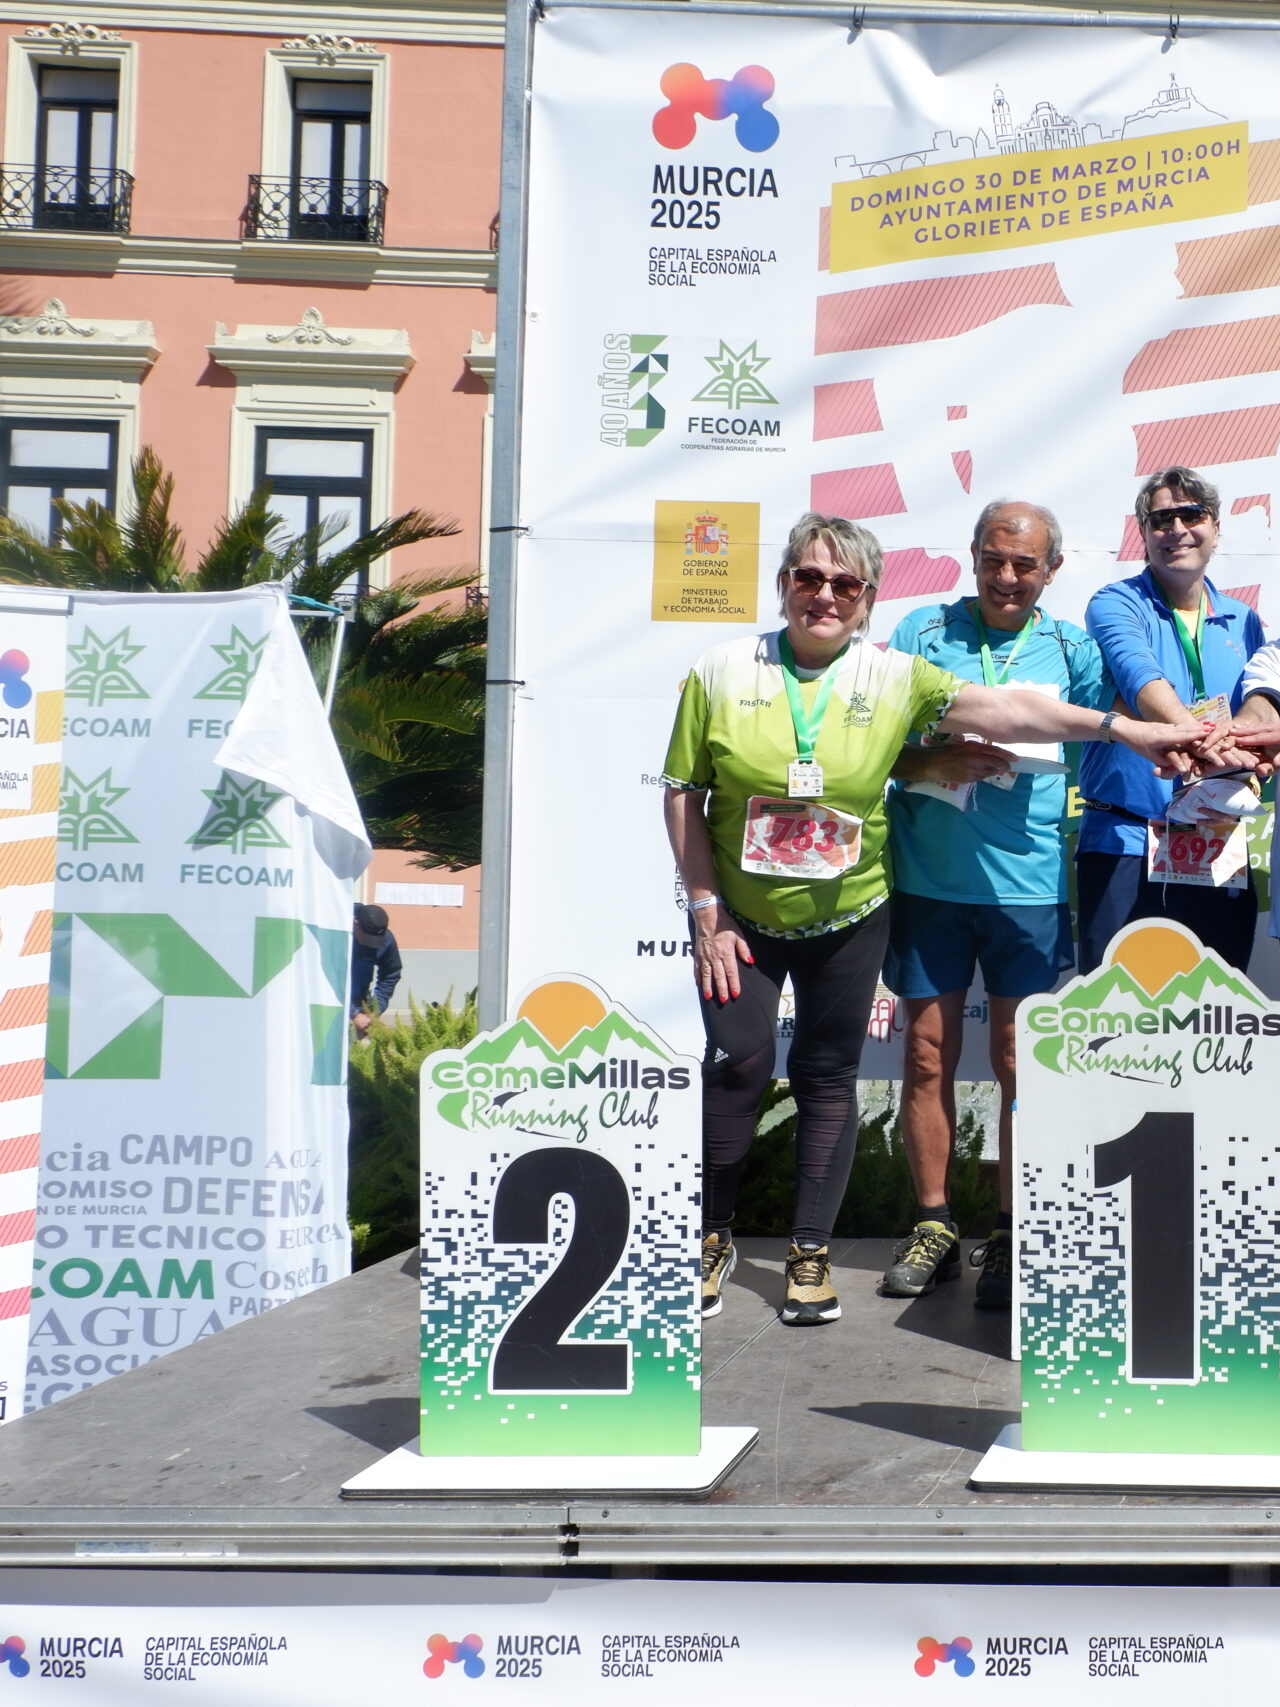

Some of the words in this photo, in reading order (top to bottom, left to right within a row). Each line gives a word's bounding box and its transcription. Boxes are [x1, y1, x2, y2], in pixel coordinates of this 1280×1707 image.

[652, 164, 779, 198] MURCIA
[850, 178, 965, 212] DOMINGO
[975, 172, 1002, 189] 30
[1012, 168, 1041, 187] DE
[1052, 155, 1137, 182] MARZO
[1160, 139, 1242, 166] 10:00H
[879, 188, 1067, 229] AYUNTAMIENTO
[1077, 182, 1106, 200] DE
[1116, 166, 1210, 195] MURCIA
[650, 200, 721, 229] 2025
[914, 217, 1031, 244] GLORIETA
[1041, 210, 1070, 228] DE
[1080, 193, 1174, 222] ESPAÑA
[649, 247, 702, 261] CAPITAL
[707, 247, 777, 263] ESPAÑOLA
[648, 260, 666, 273] DE
[670, 261, 687, 273] LA
[648, 273, 696, 287] SOCIAL
[597, 333, 631, 410] AÑOS
[600, 413, 628, 447] 40
[687, 417, 781, 437] FECOAM
[681, 444, 724, 452] COOPERATIVAS
[725, 445, 755, 453] AGRARIAS
[711, 437, 748, 446] FEDERACIÓN
[682, 568, 693, 576] DE
[695, 567, 728, 577] ESPAÑA
[683, 559, 728, 568] GOBIERNO
[682, 588, 728, 596] MINISTERIO
[670, 605, 716, 614] ECONOMÍA
[717, 606, 746, 614] SOCIAL
[693, 597, 729, 607] TRABAJO
[740, 699, 771, 708] FASTER
[844, 714, 873, 723] FECOAM
[770, 815, 839, 852] 783
[180, 864, 294, 888] FECOAM
[1067, 1035, 1182, 1088] Running
[1193, 1037, 1253, 1076] Club
[431, 1058, 690, 1090] ComeMillas
[471, 1090, 589, 1143] Running
[599, 1090, 659, 1130] Club
[40, 1142, 112, 1172] cia
[120, 1133, 253, 1167] CAMPO
[55, 1205, 77, 1215] DE
[82, 1205, 148, 1216] MURCIA
[84, 1225, 266, 1251] TECNICO
[1094, 1112, 1196, 1381] 1
[492, 1147, 631, 1391] 2
[40, 1637, 124, 1658] MURCIA
[146, 1636, 205, 1651] CAPITAL
[209, 1633, 288, 1651] ESPAÑOLA
[497, 1635, 581, 1656] MURCIA
[602, 1635, 660, 1648] CAPITAL
[665, 1633, 740, 1649] ESPAÑOLA
[986, 1637, 1069, 1655] MURCIA
[1088, 1637, 1146, 1649] CAPITAL
[1150, 1634, 1224, 1649] ESPAÑOLA
[144, 1652, 163, 1666] DE
[168, 1652, 186, 1666] LA
[602, 1650, 620, 1663] DE
[625, 1650, 644, 1663] LA
[1088, 1650, 1107, 1663] DE
[1111, 1650, 1129, 1663] LA
[40, 1660, 86, 1679] 2025
[144, 1667, 197, 1681] SOCIAL
[495, 1658, 543, 1678] 2025
[601, 1663, 653, 1677] SOCIAL
[985, 1657, 1031, 1677] 2025
[1088, 1664, 1140, 1677] SOCIAL
